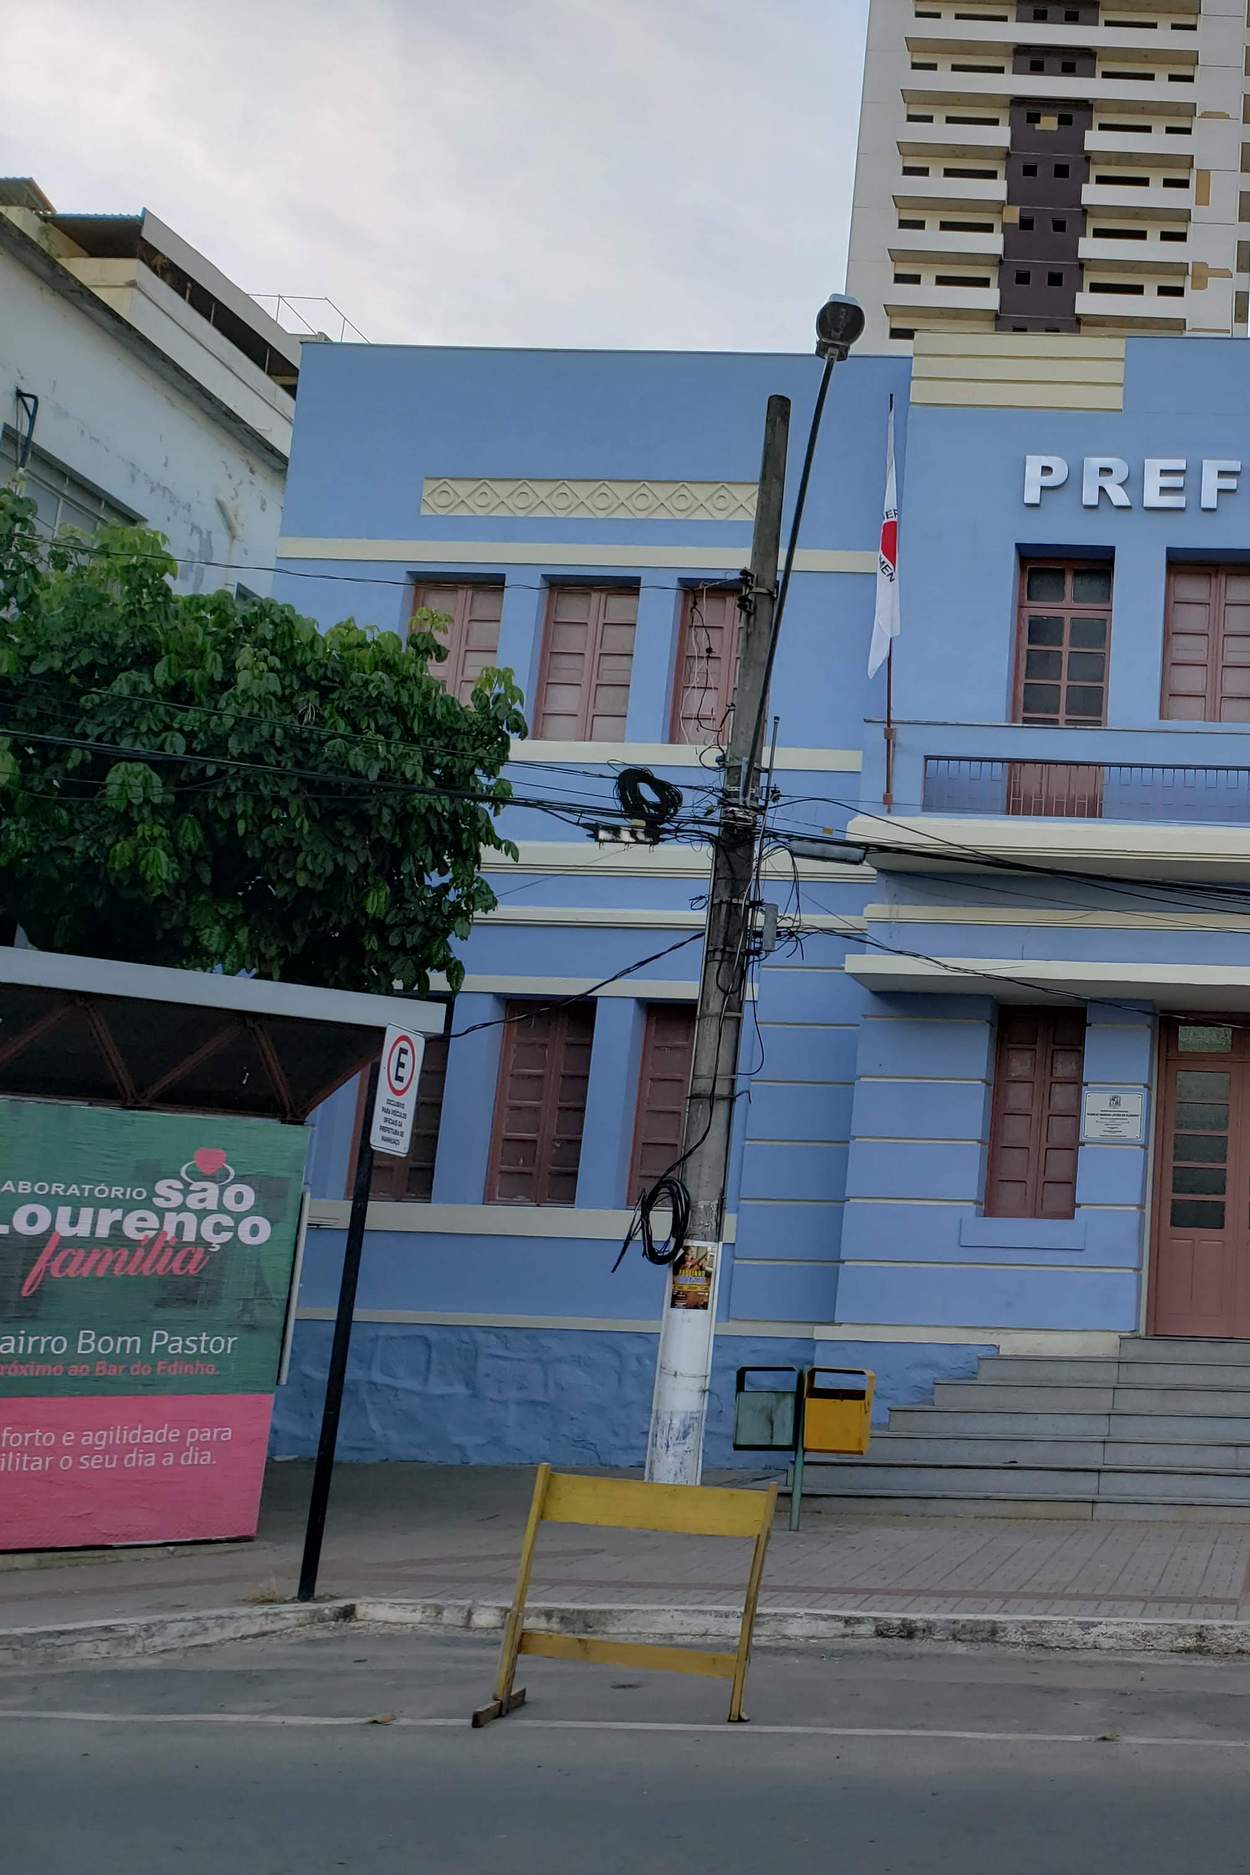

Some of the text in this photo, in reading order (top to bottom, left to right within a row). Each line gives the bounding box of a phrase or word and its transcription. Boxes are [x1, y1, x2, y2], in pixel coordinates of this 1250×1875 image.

[394, 1046, 409, 1083] E
[0, 1203, 272, 1252] ourenço
[0, 1330, 238, 1355] airro Bom Pastor
[96, 1361, 124, 1376] Bar
[130, 1361, 151, 1376] do
[62, 1431, 75, 1446] e
[81, 1425, 180, 1449] agilidade
[187, 1427, 232, 1447] para
[60, 1456, 72, 1470] o
[79, 1453, 117, 1469] seu
[124, 1449, 156, 1467] dia
[162, 1453, 175, 1466] a
[180, 1447, 216, 1465] dia.
